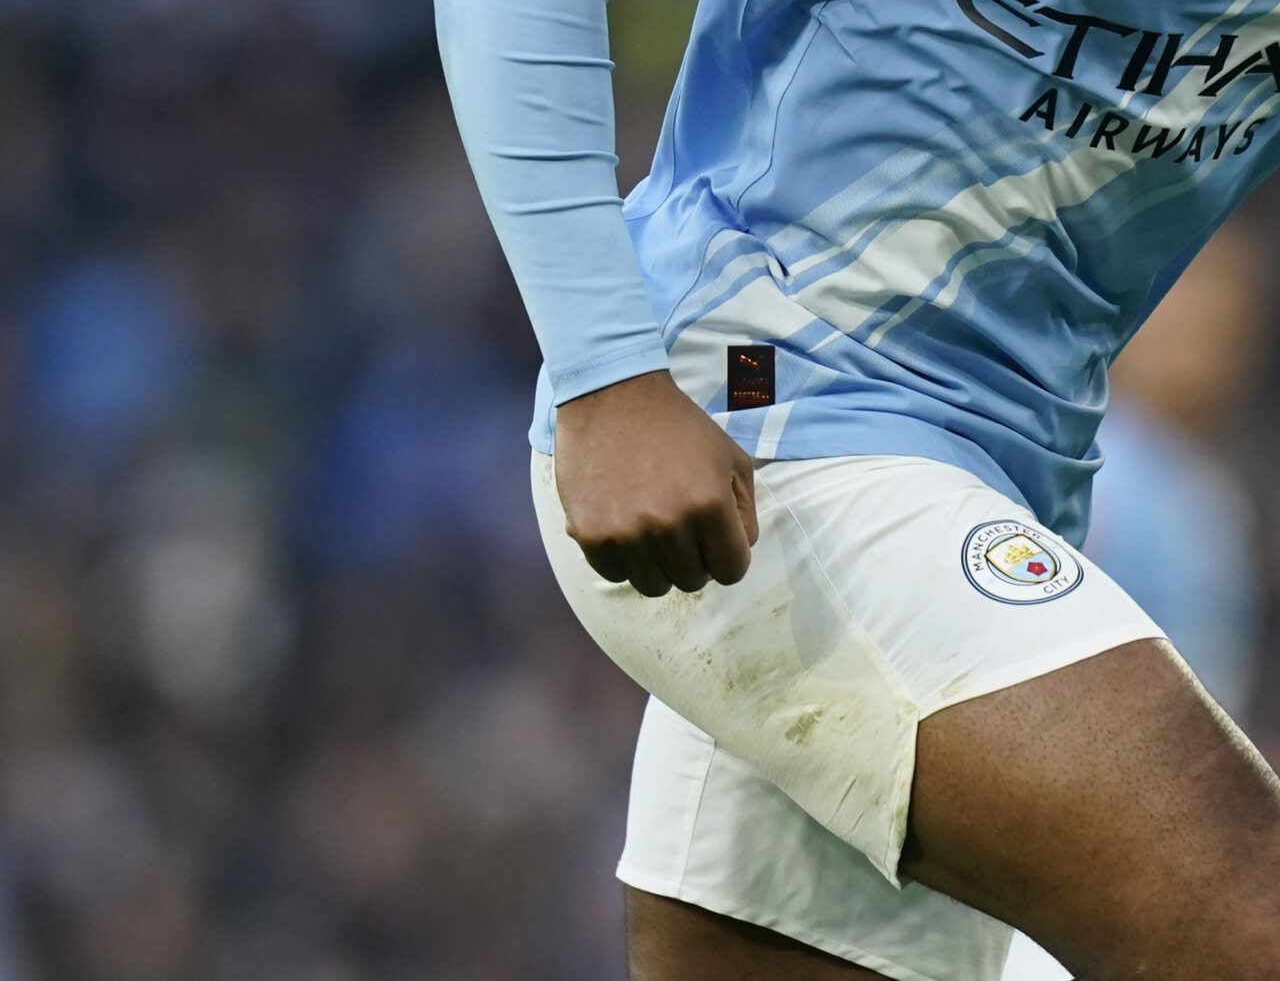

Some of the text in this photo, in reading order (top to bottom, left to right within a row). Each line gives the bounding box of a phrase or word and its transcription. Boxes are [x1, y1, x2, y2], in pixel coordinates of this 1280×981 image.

[1018, 87, 1267, 164] AIRWAYS
[972, 525, 1041, 571] MANCHESTER
[1043, 576, 1070, 594] CITY
